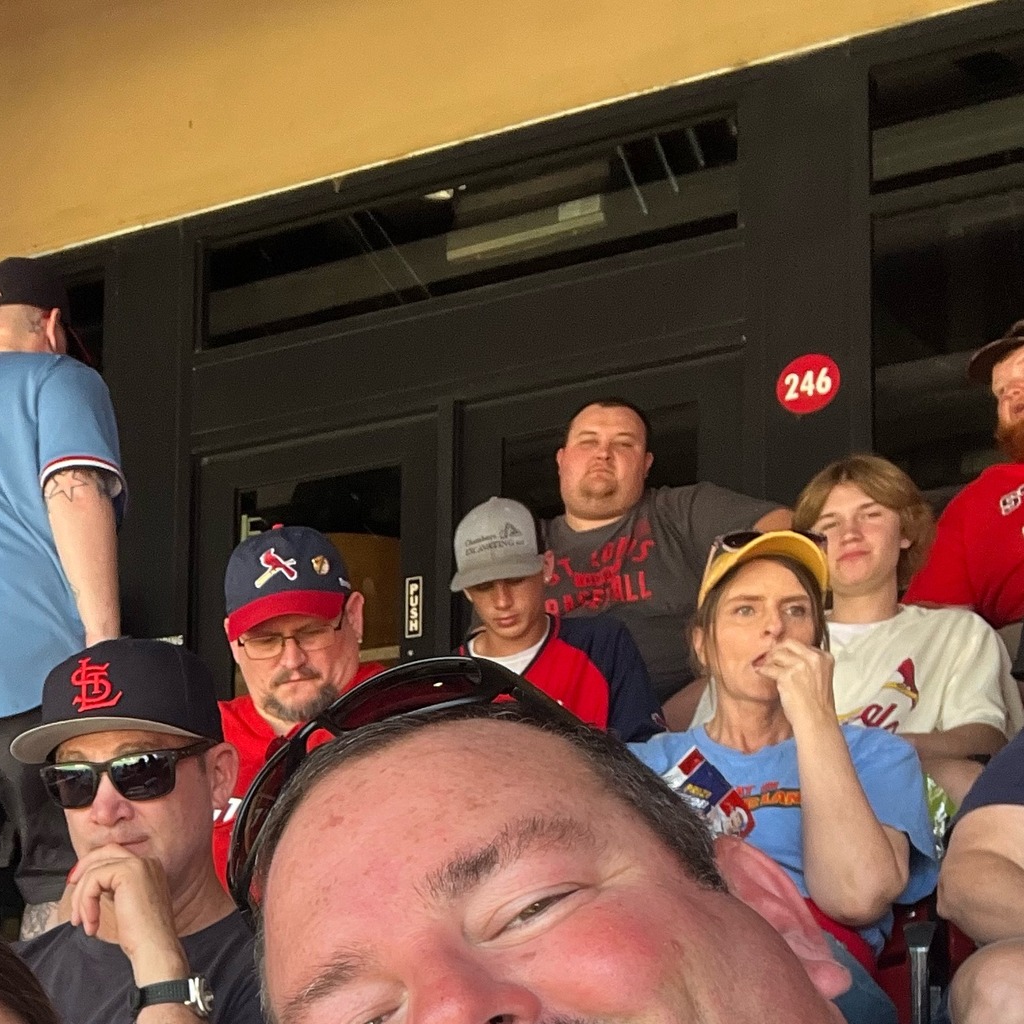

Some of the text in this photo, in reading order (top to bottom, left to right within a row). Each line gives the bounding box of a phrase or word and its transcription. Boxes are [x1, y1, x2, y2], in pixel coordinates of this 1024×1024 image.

[784, 366, 833, 402] 246
[408, 582, 420, 633] PUSH
[544, 570, 653, 615] BASEALL
